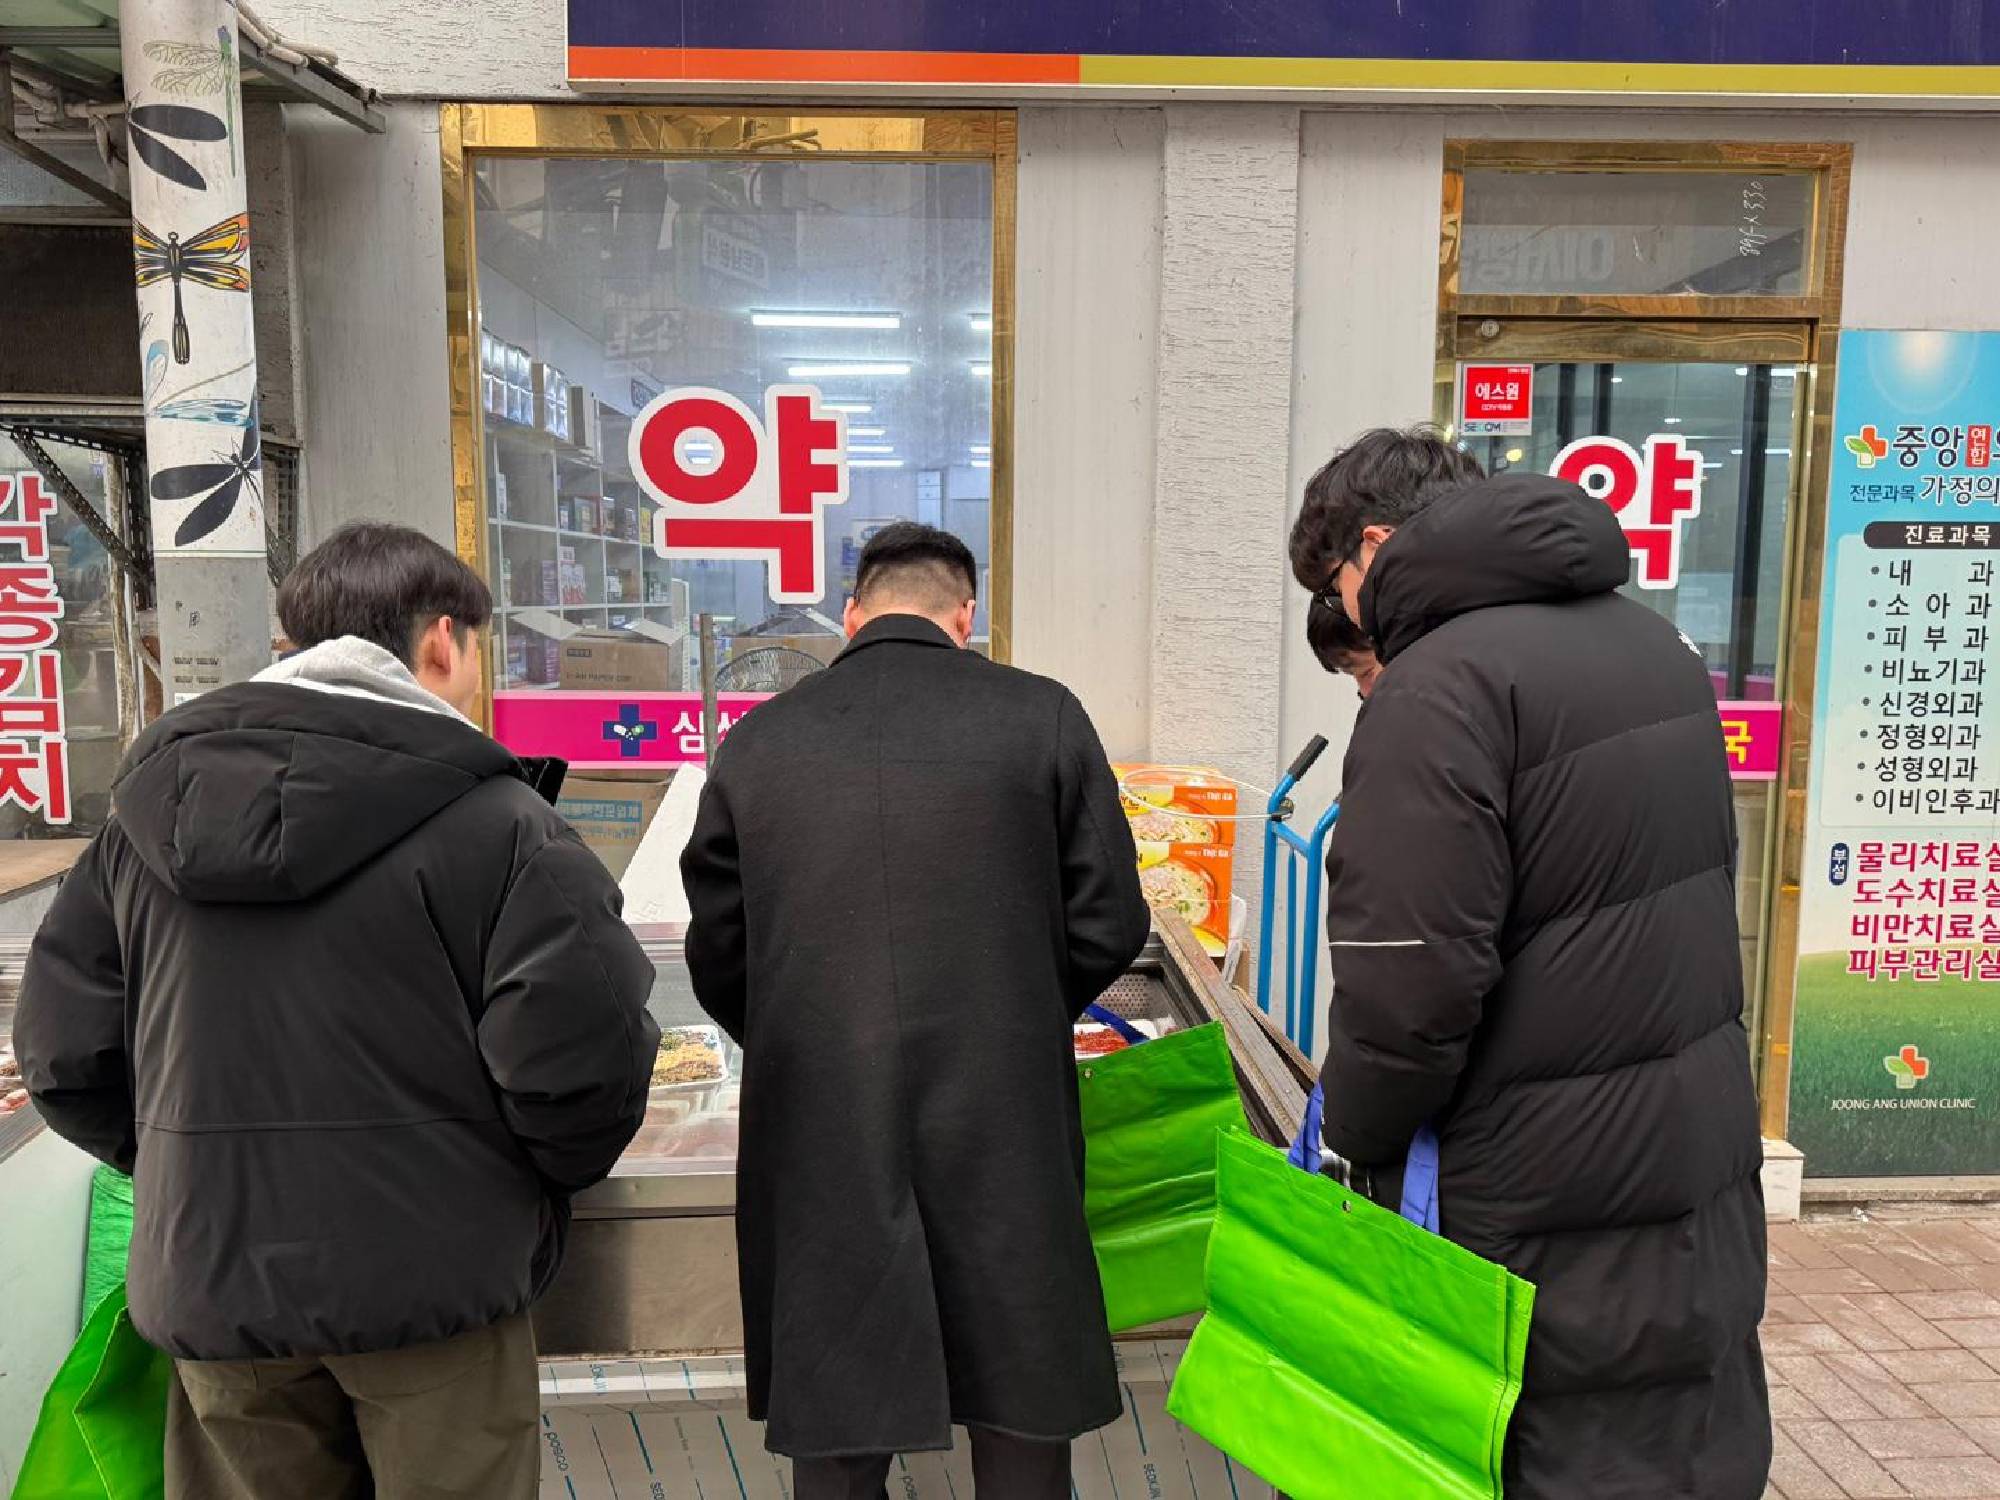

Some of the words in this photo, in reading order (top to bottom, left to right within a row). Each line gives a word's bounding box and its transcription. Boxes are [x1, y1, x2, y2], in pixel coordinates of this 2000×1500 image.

[1474, 382, 1520, 401] 에스원
[1892, 425, 1965, 468] 중앙
[1970, 427, 1987, 466] 연합
[634, 391, 843, 597] 약
[1850, 484, 1916, 503] 전문과목
[1553, 438, 1700, 585] 약
[1905, 524, 1991, 546] 진료과목
[1882, 658, 1986, 685] 비뇨기과
[1880, 691, 1983, 718] 신경외과
[1877, 724, 1981, 750] 정형외과
[1874, 756, 1978, 782] 성형외과
[1873, 788, 2000, 815] 이비인후과
[1832, 849, 1846, 880] 부설
[1848, 949, 2000, 980] 피부관리실
[1831, 1099, 1869, 1111] JOONG
[1872, 1099, 1897, 1110] ANG
[1900, 1098, 1937, 1109] UNION
[1940, 1098, 1976, 1109] CLINIC
[544, 1431, 569, 1471] posco
